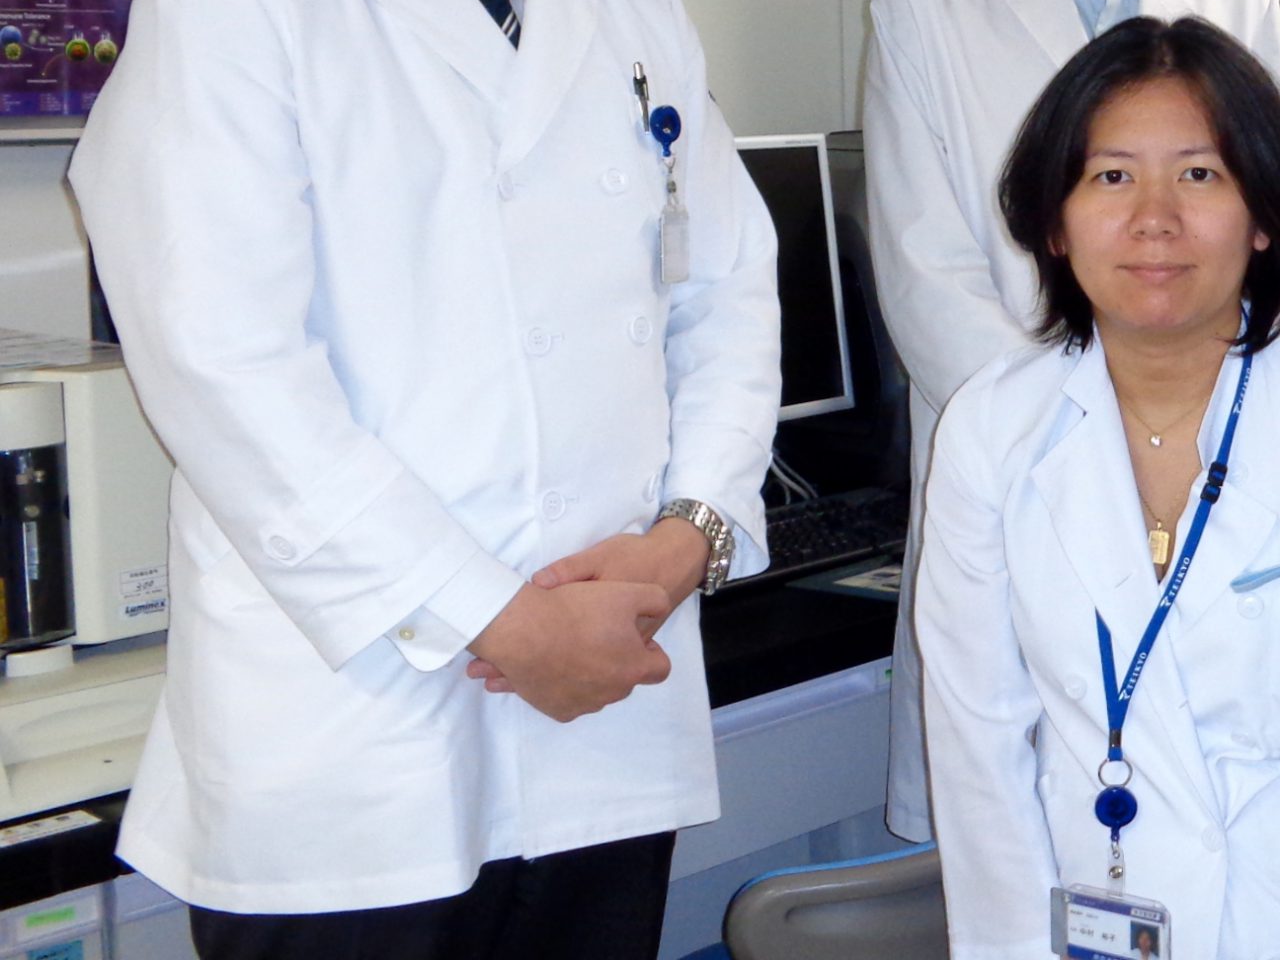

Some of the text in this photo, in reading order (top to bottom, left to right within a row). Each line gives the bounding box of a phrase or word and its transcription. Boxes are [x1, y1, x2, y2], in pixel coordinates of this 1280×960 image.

[1168, 556, 1191, 597] TEIKYO
[125, 599, 167, 615] Luminex
[1126, 651, 1147, 690] TEIKYO
